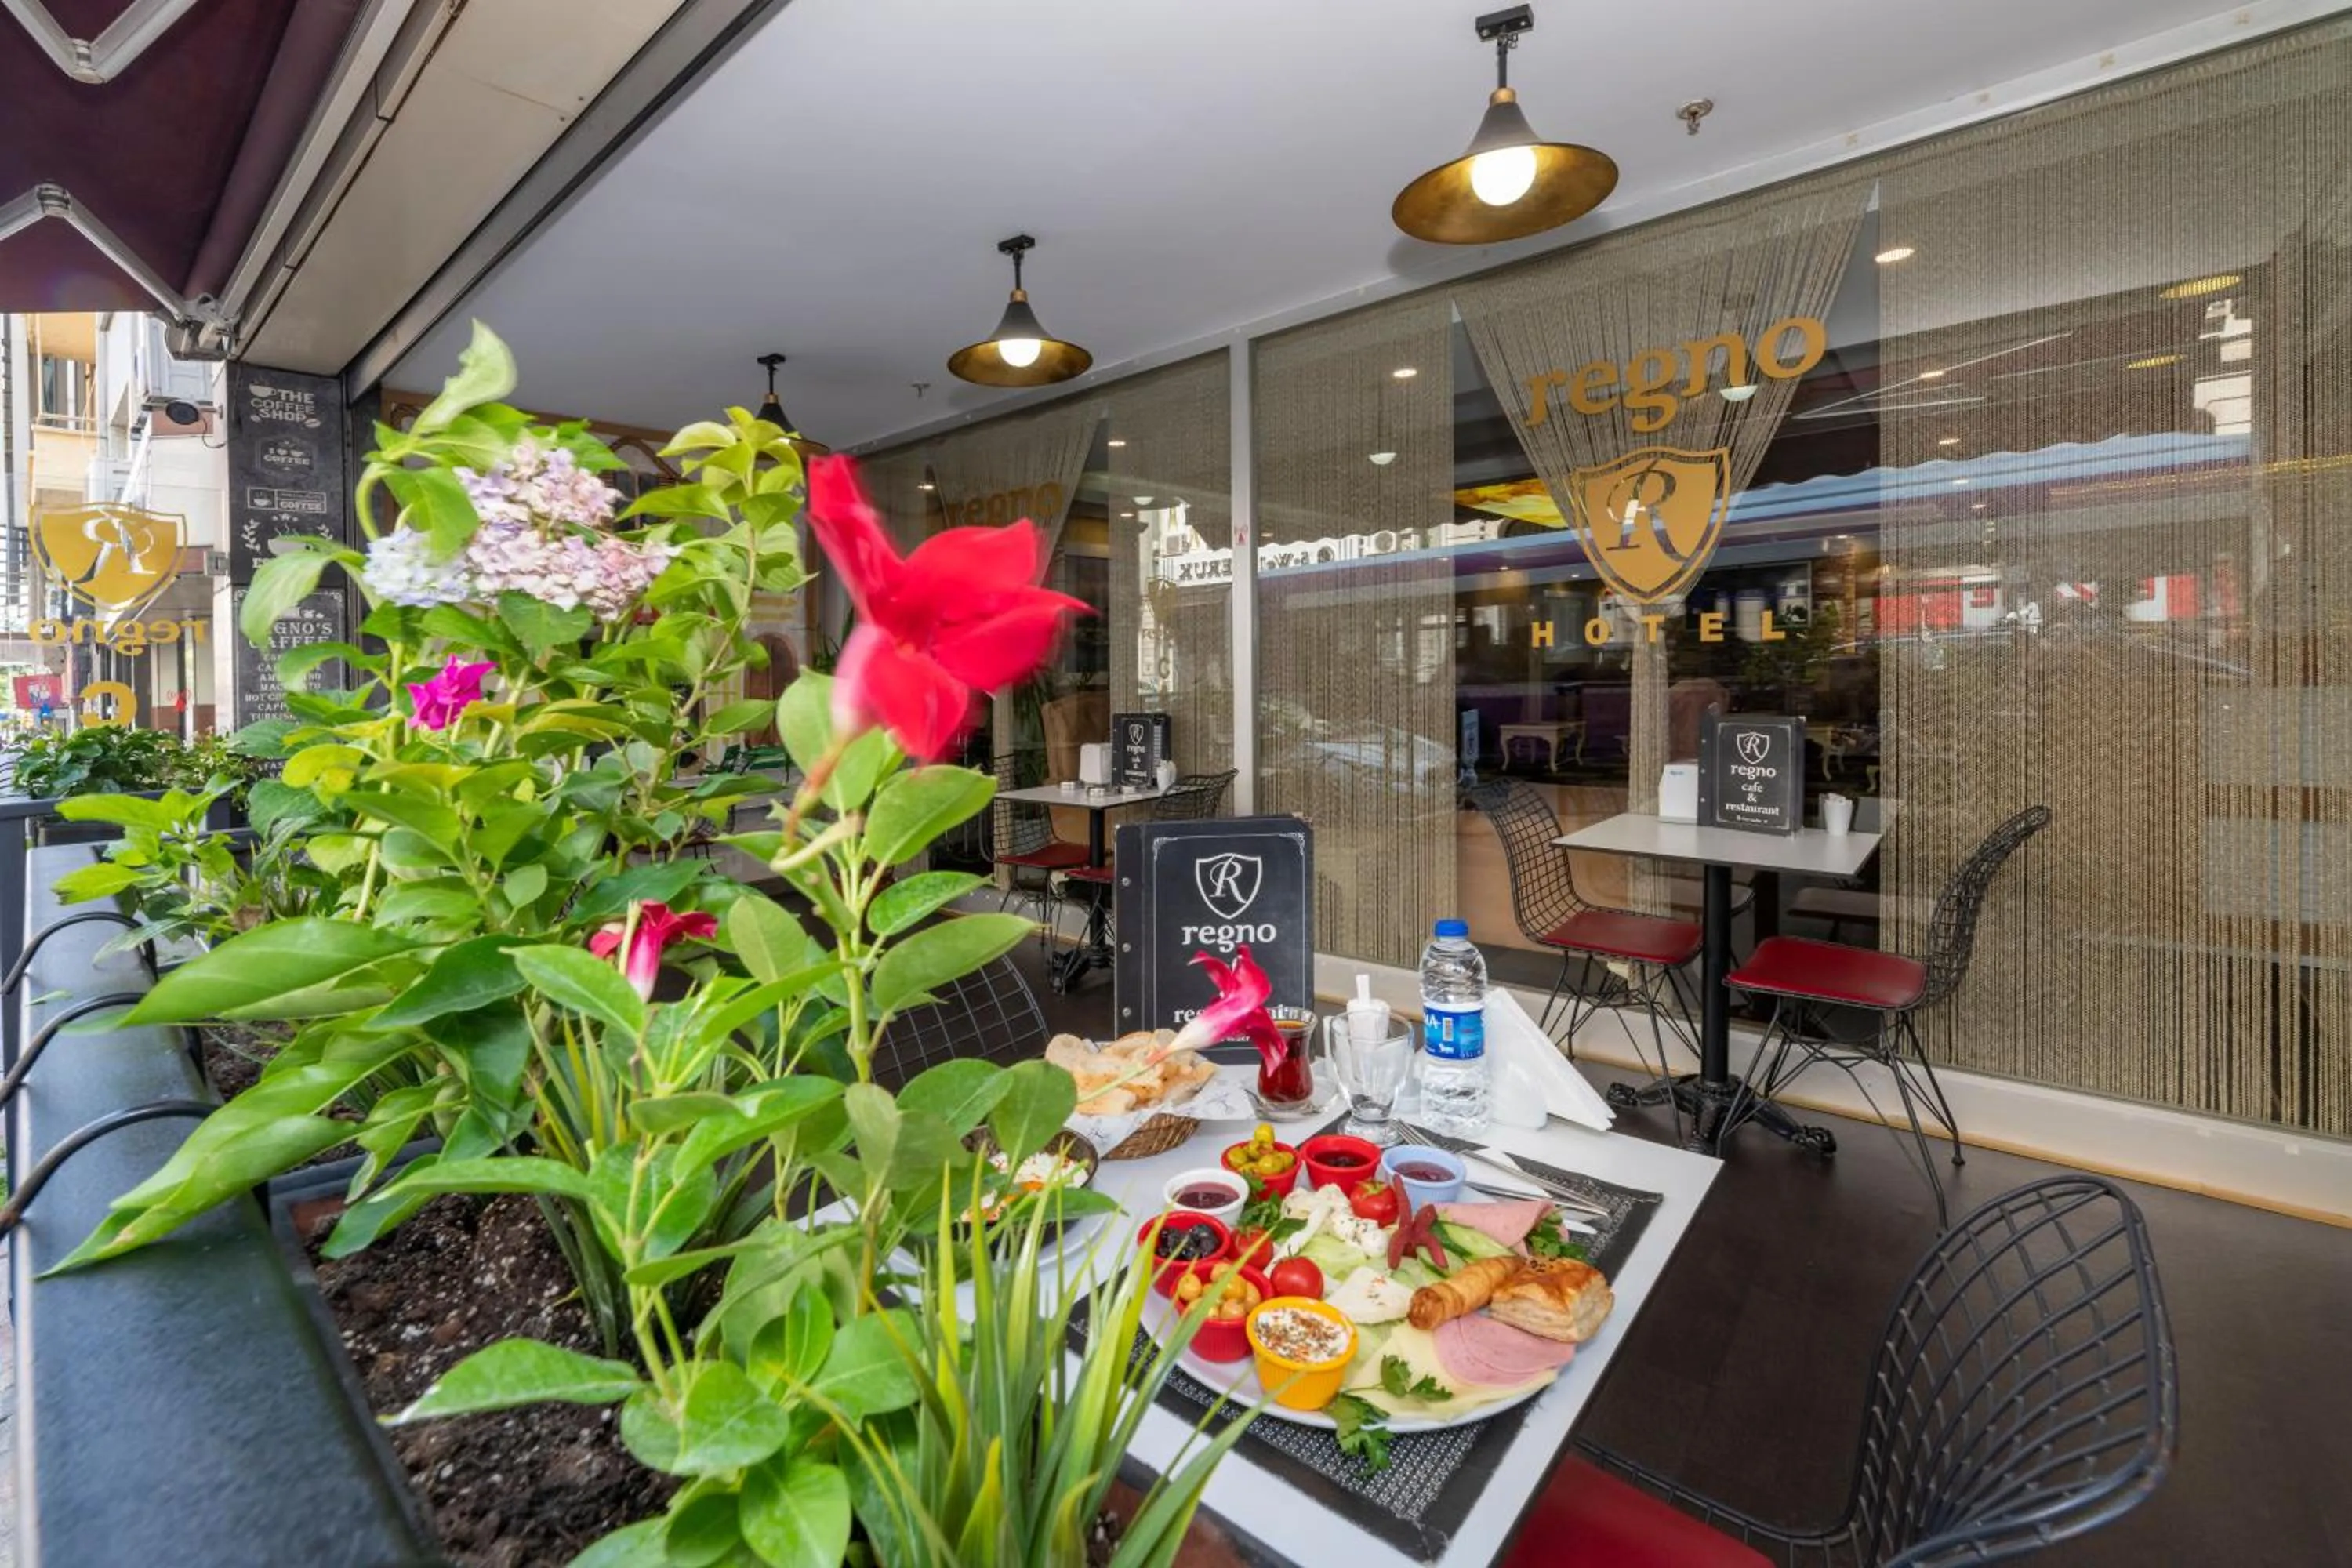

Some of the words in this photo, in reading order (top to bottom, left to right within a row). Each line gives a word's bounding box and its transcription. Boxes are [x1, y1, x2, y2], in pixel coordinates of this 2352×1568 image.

[1526, 316, 1828, 433] regno
[275, 388, 315, 404] THE
[250, 397, 316, 414] COFFEE
[258, 408, 307, 423] SHOP
[263, 454, 310, 466] COFFEE
[280, 500, 322, 511] COFFEE
[274, 622, 333, 635] GNO'S
[1531, 610, 1785, 648] HOTEL
[1730, 764, 1777, 780] regno
[1741, 782, 1763, 793] cafe
[1747, 793, 1757, 803] &
[1726, 803, 1780, 816] restaurant
[1209, 854, 1249, 905] R
[1181, 921, 1277, 952] regno
